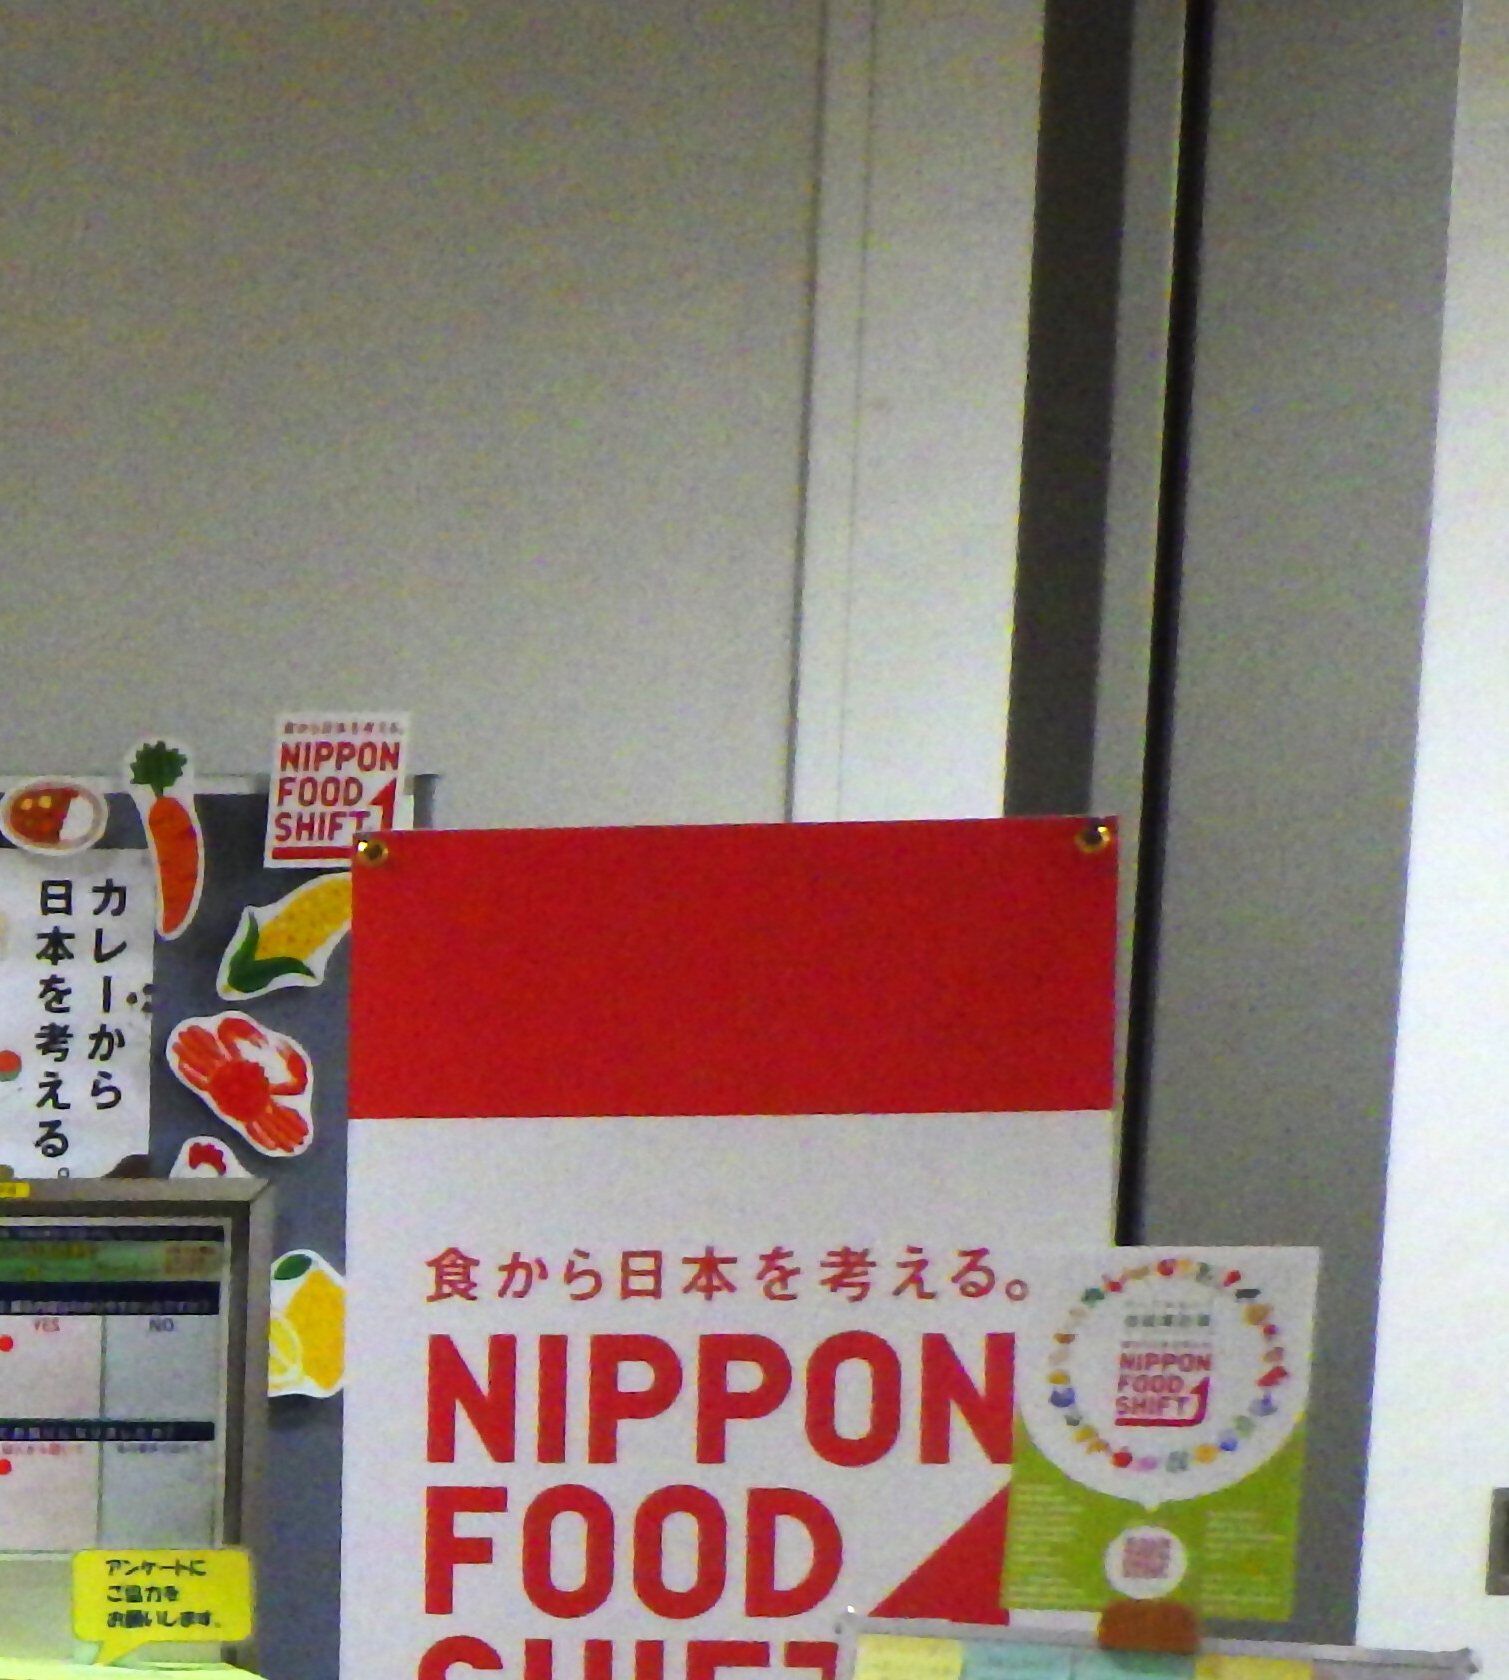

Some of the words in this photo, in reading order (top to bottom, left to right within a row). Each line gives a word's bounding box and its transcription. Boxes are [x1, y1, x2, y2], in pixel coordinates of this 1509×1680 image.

[279, 739, 402, 773] NIPPON
[277, 775, 366, 807] FOOD
[273, 809, 373, 844] SHIFT
[87, 878, 129, 1112] カレーから
[31, 877, 76, 1180] 日本を考える。
[425, 1245, 1030, 1305] 食から日本を考える。
[32, 1317, 62, 1333] YES
[149, 1317, 176, 1333] NO
[1119, 1353, 1212, 1371] NIPPON
[426, 1330, 1015, 1467] NIPPON
[1117, 1375, 1184, 1394] FOOD
[1115, 1396, 1190, 1416] SHIFT
[105, 1558, 207, 1579] アンケートに
[423, 1483, 845, 1621] FOOD
